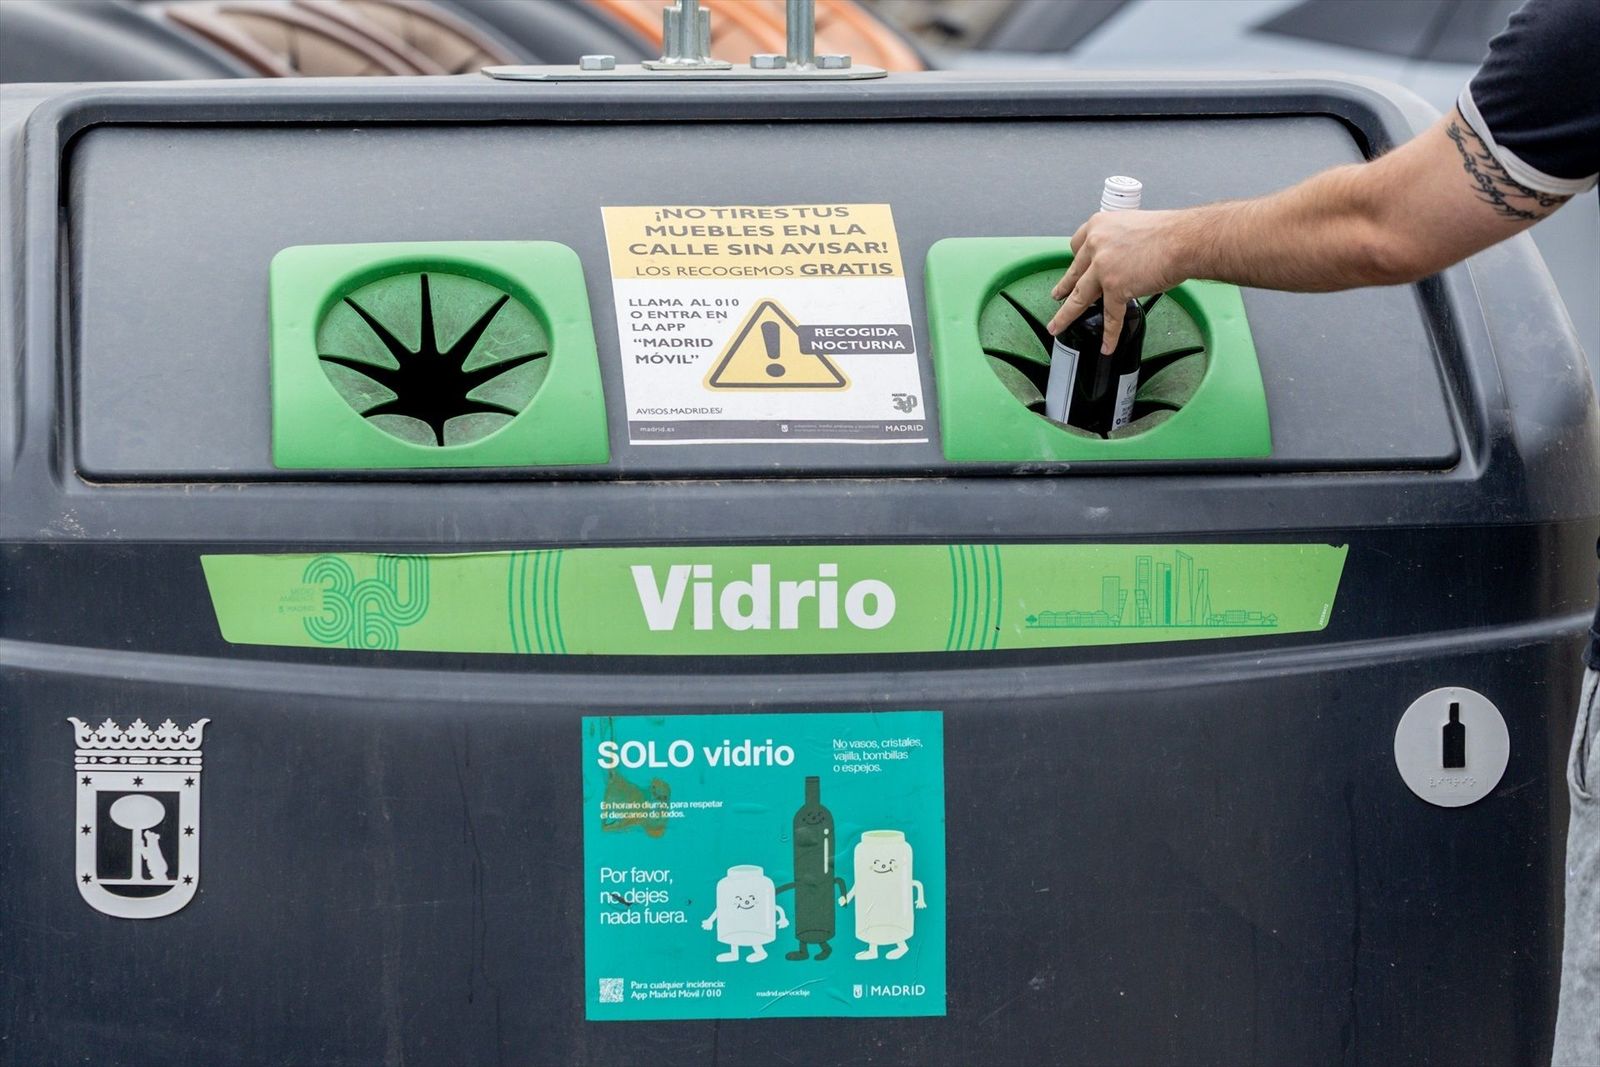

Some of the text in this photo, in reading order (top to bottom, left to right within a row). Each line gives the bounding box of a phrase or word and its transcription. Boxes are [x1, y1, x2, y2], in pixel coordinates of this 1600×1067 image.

[710, 208, 789, 219] TIRES
[792, 206, 850, 218] TUS
[645, 223, 866, 237] MUEBLES EN LA
[629, 241, 889, 255] CALLE SIN AVISAR!
[636, 262, 895, 276] LOS RECOGEMOS GRATIS
[629, 298, 740, 307] LLAMA AL 010
[630, 310, 728, 319] O ENTRA EN
[632, 323, 686, 332] LA APP
[814, 326, 899, 337] RECOGIDA
[810, 339, 906, 350] NOCTURNA
[636, 407, 723, 415] AVISOS.MADRID.ES/
[885, 424, 924, 432] MADRID
[630, 563, 896, 631] Vidrio
[832, 737, 924, 750] No vasos, cristales,
[597, 738, 796, 769] SOLO vidrio
[833, 750, 909, 762] vajilla, bombillas
[833, 763, 882, 774] o espejos.
[600, 801, 612, 810] En
[612, 801, 641, 810] horario
[670, 801, 689, 811] para
[690, 800, 723, 810] respetar
[600, 809, 685, 819] el descanso de todos.
[600, 866, 673, 885] Por favor,
[600, 887, 669, 907] no dejes
[600, 907, 688, 925] nada fuera.
[631, 980, 726, 990] Para cualquier incidencia:
[870, 984, 926, 997] MADRID
[631, 991, 648, 1000] App
[649, 990, 677, 998] Madrid
[706, 989, 722, 997] 010
